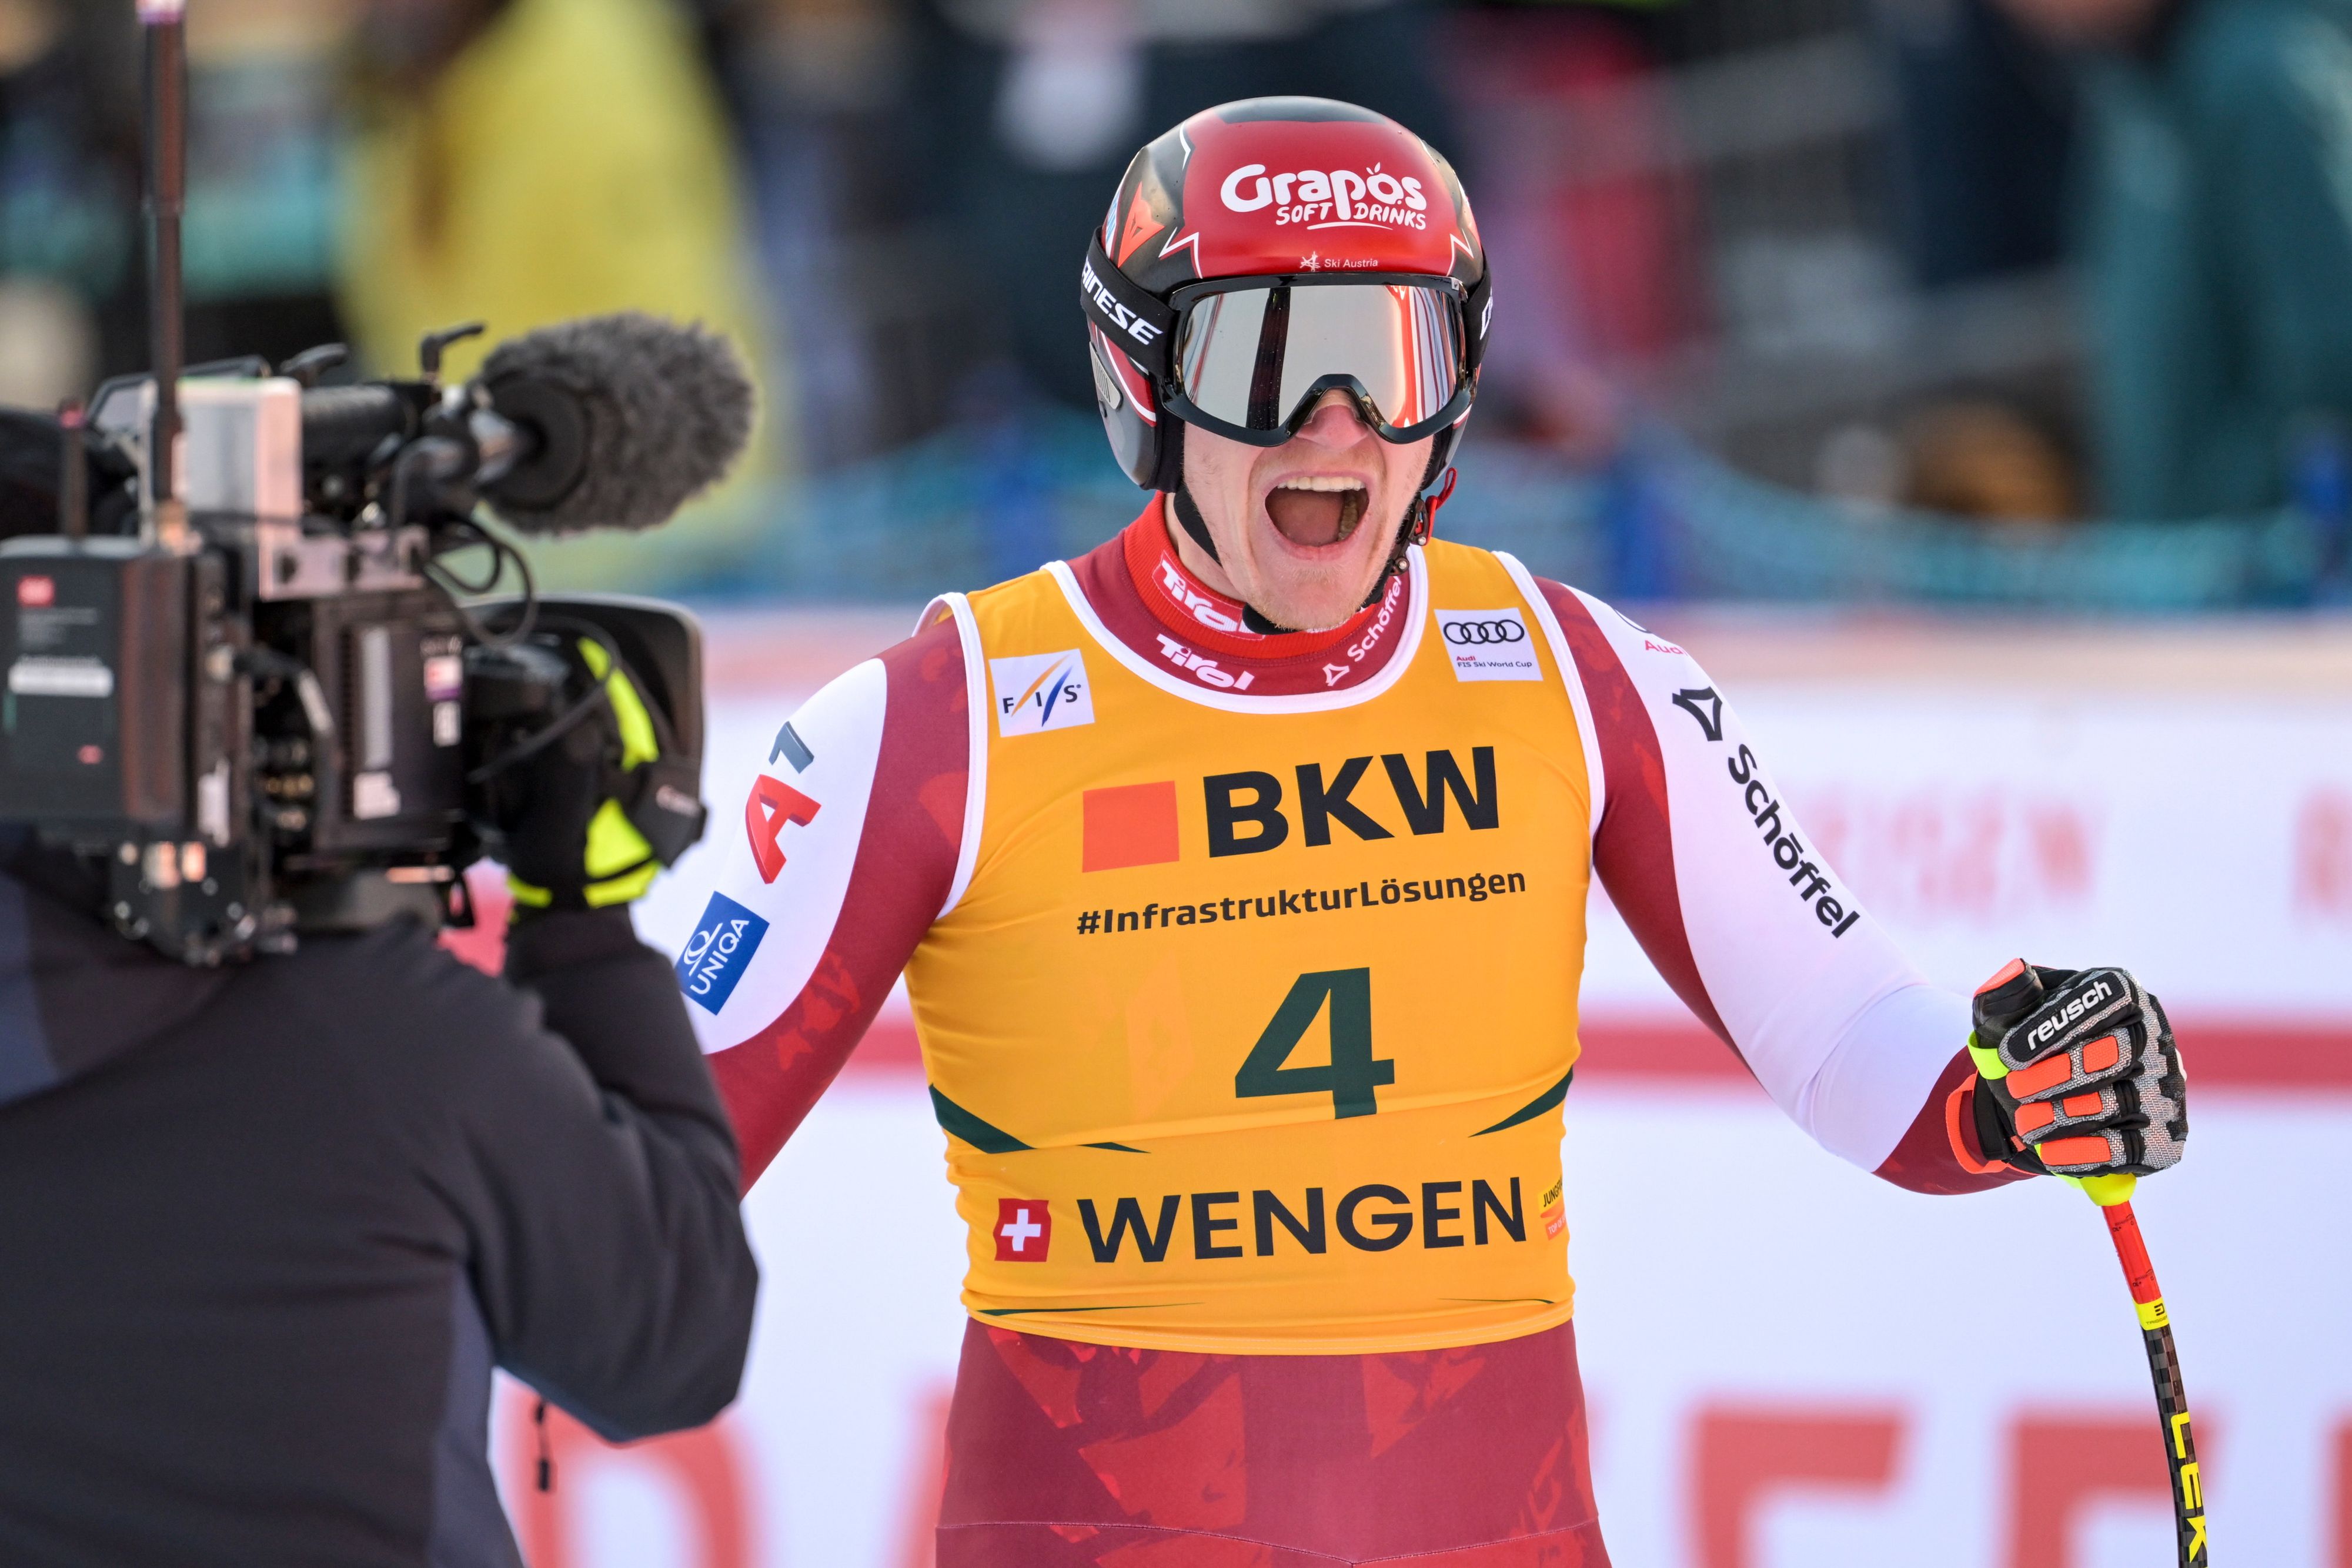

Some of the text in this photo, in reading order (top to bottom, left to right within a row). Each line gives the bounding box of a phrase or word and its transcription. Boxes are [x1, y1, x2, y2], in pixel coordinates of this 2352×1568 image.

[1275, 202, 1426, 230] SOFT DRINKS
[1082, 255, 1164, 345] AINESE
[1324, 258, 1378, 268] Ski Austria
[1160, 559, 1257, 634] Tiro
[1002, 684, 1081, 714] FIS
[1156, 633, 1255, 691] Tirol
[744, 721, 822, 885] A1
[1202, 745, 1499, 859] BKW
[1077, 871, 1526, 935] #InfrastrukturLösungen
[689, 919, 750, 995] UNIQA
[1235, 967, 1395, 1120] 4
[2027, 980, 2113, 1051] reusch
[1076, 1176, 1527, 1264] WENGEN
[2171, 1412, 2208, 1568] LEK
